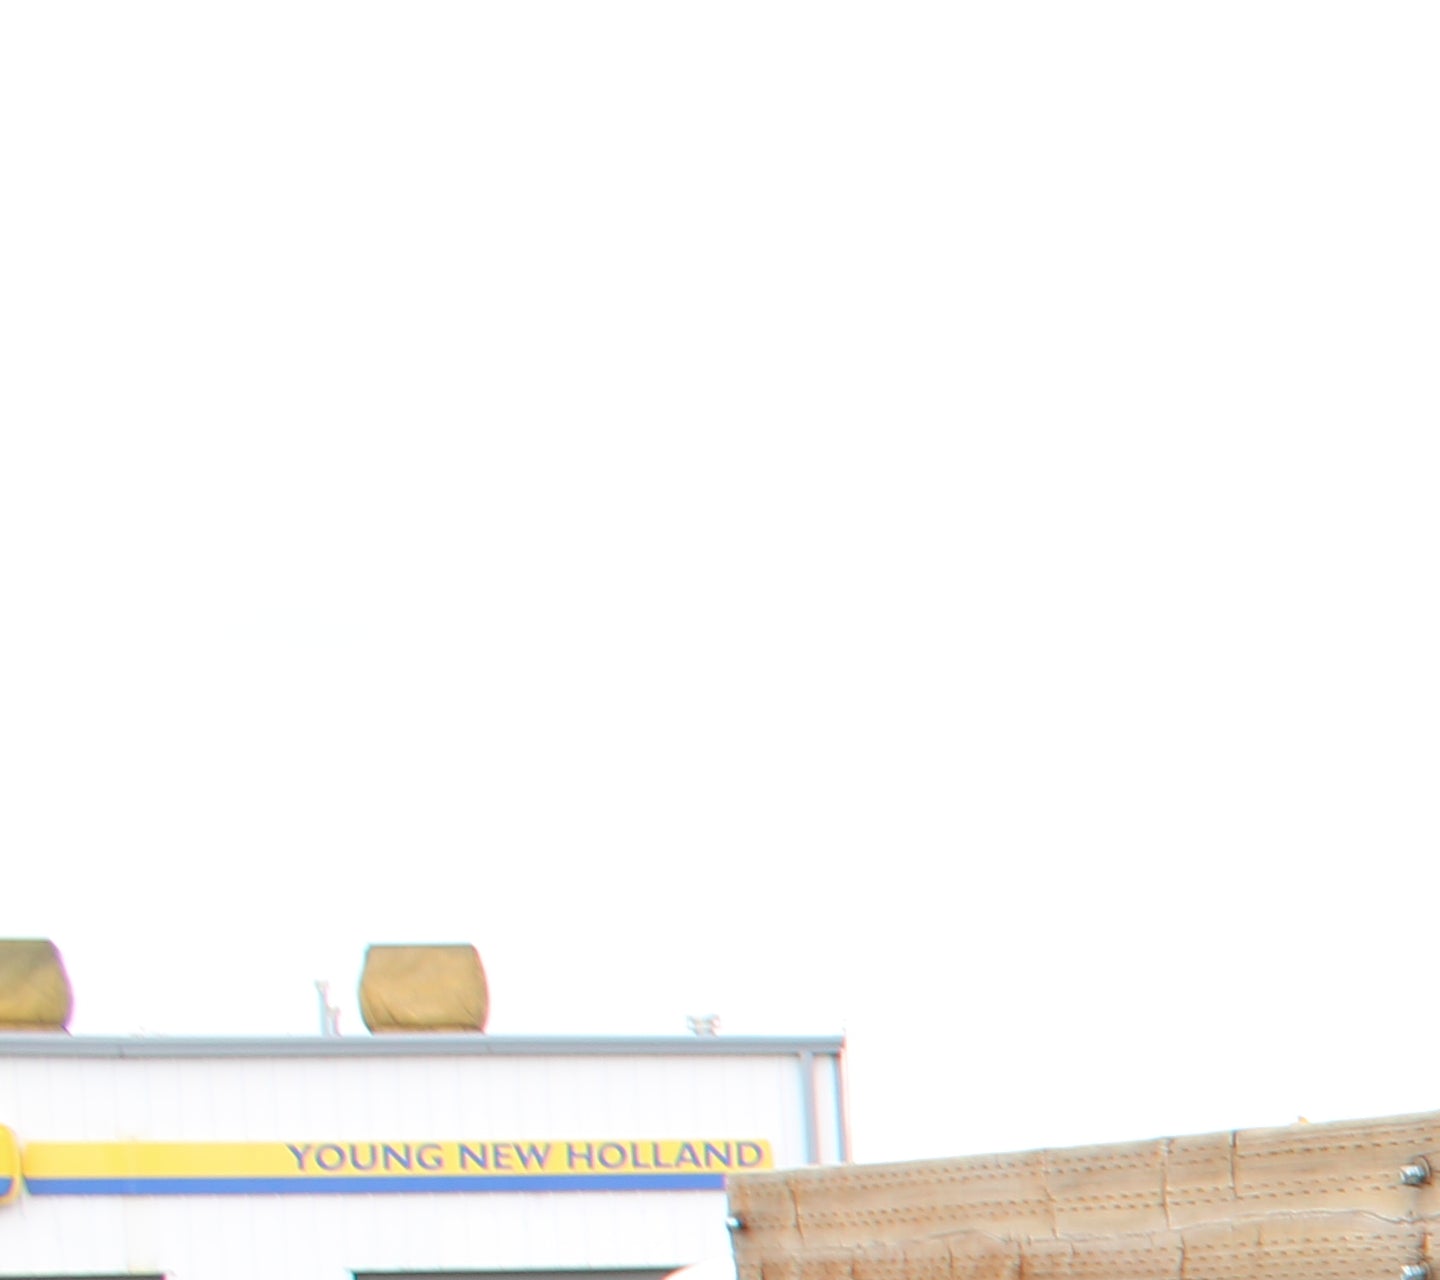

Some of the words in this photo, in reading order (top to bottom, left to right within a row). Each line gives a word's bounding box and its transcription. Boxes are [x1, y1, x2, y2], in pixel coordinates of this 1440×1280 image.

[288, 1142, 443, 1171] YOUNG
[458, 1142, 551, 1171] NEW
[566, 1140, 764, 1170] HOLLAND
